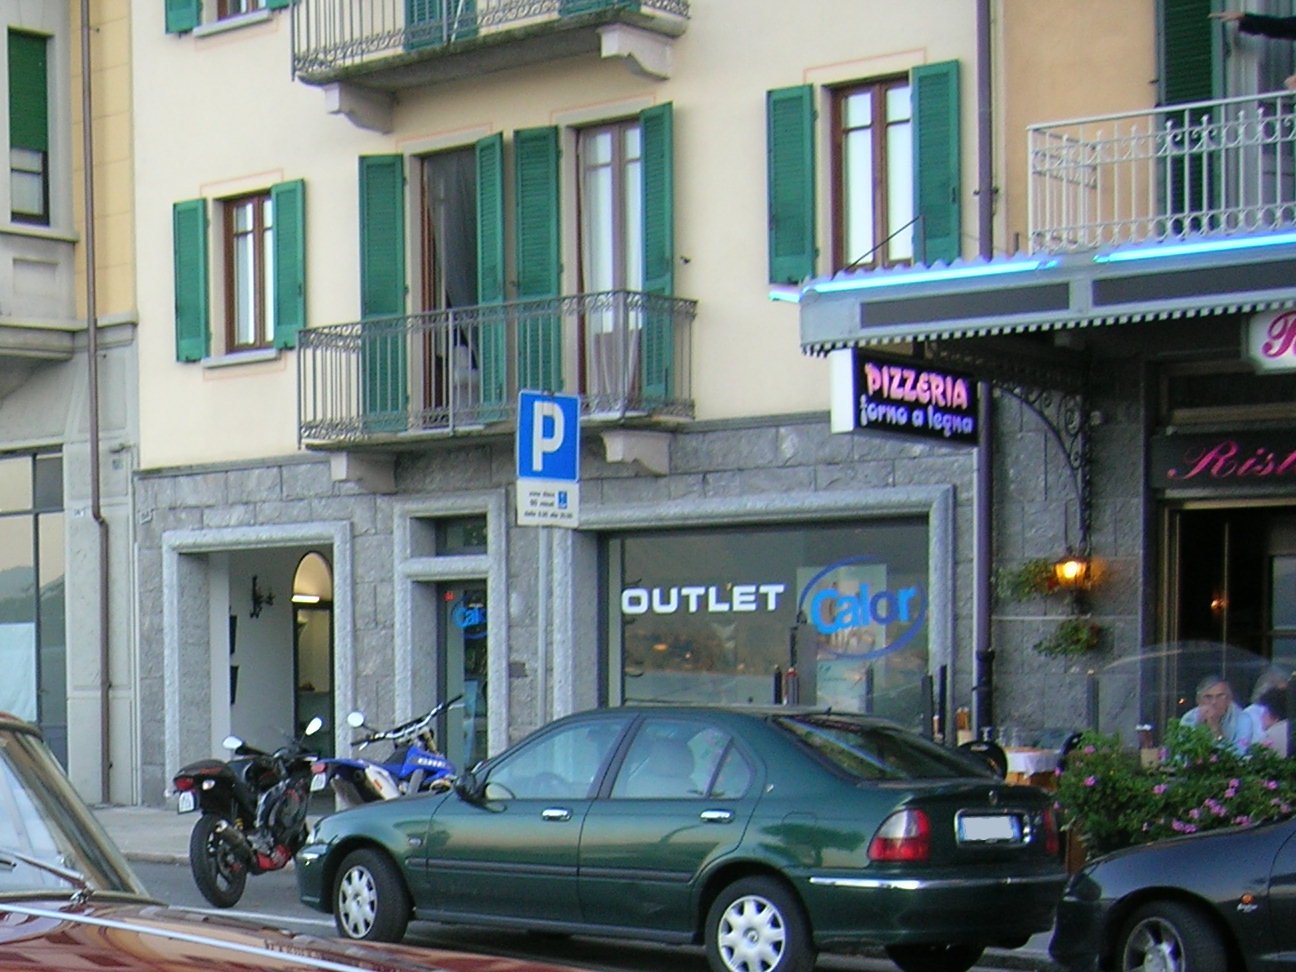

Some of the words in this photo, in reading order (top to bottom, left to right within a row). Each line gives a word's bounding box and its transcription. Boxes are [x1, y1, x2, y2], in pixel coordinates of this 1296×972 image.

[865, 362, 969, 410] PIZZERIA
[532, 400, 565, 472] P
[860, 394, 908, 426] forno
[912, 409, 924, 427] a
[927, 404, 974, 437] legna
[621, 584, 785, 615] OUTLET
[809, 583, 918, 635] Calor
